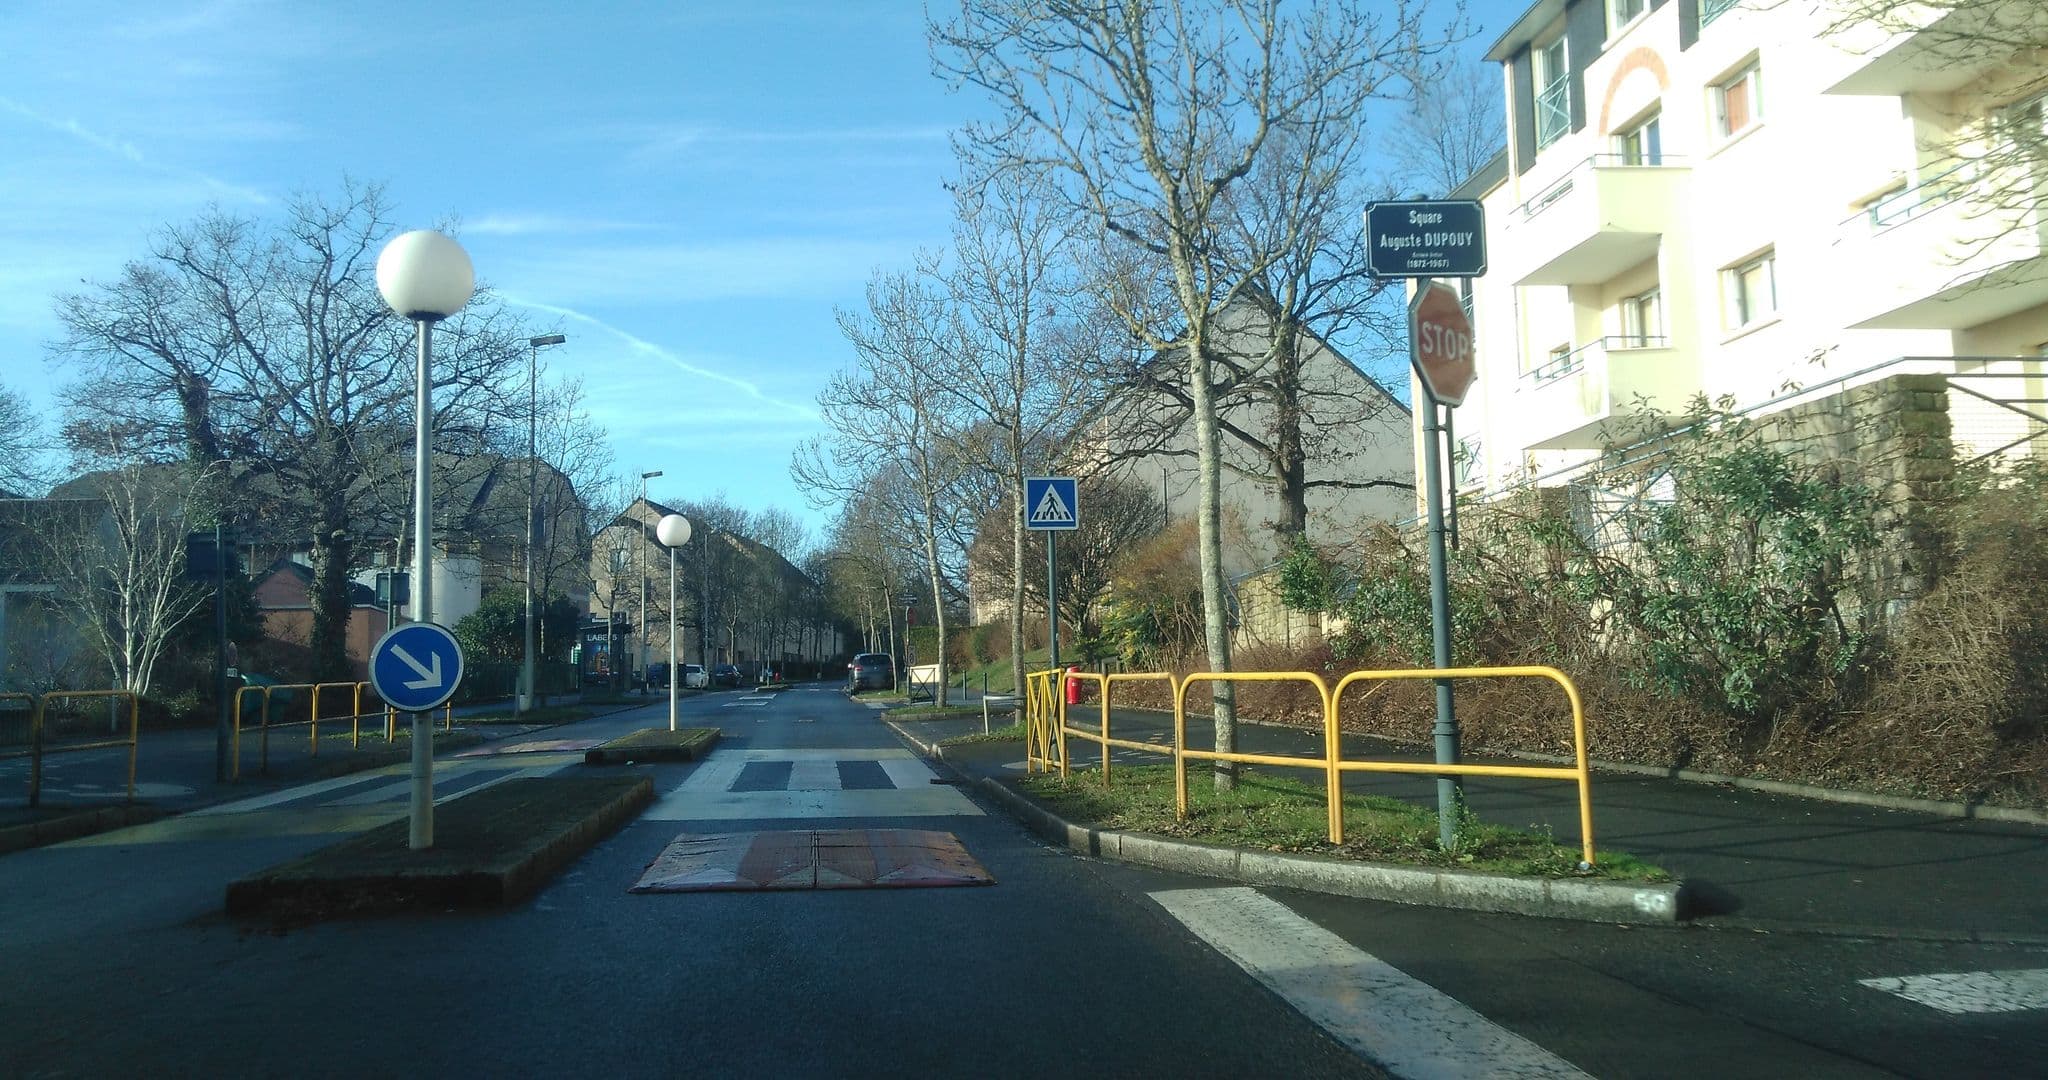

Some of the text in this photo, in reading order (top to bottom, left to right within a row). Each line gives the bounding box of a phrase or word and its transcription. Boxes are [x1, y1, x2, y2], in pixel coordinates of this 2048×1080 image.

[1409, 210, 1443, 227] Square
[1380, 232, 1473, 251] Auguste DUPOUY
[1422, 321, 1469, 362] STOP
[587, 633, 618, 641] LABES
